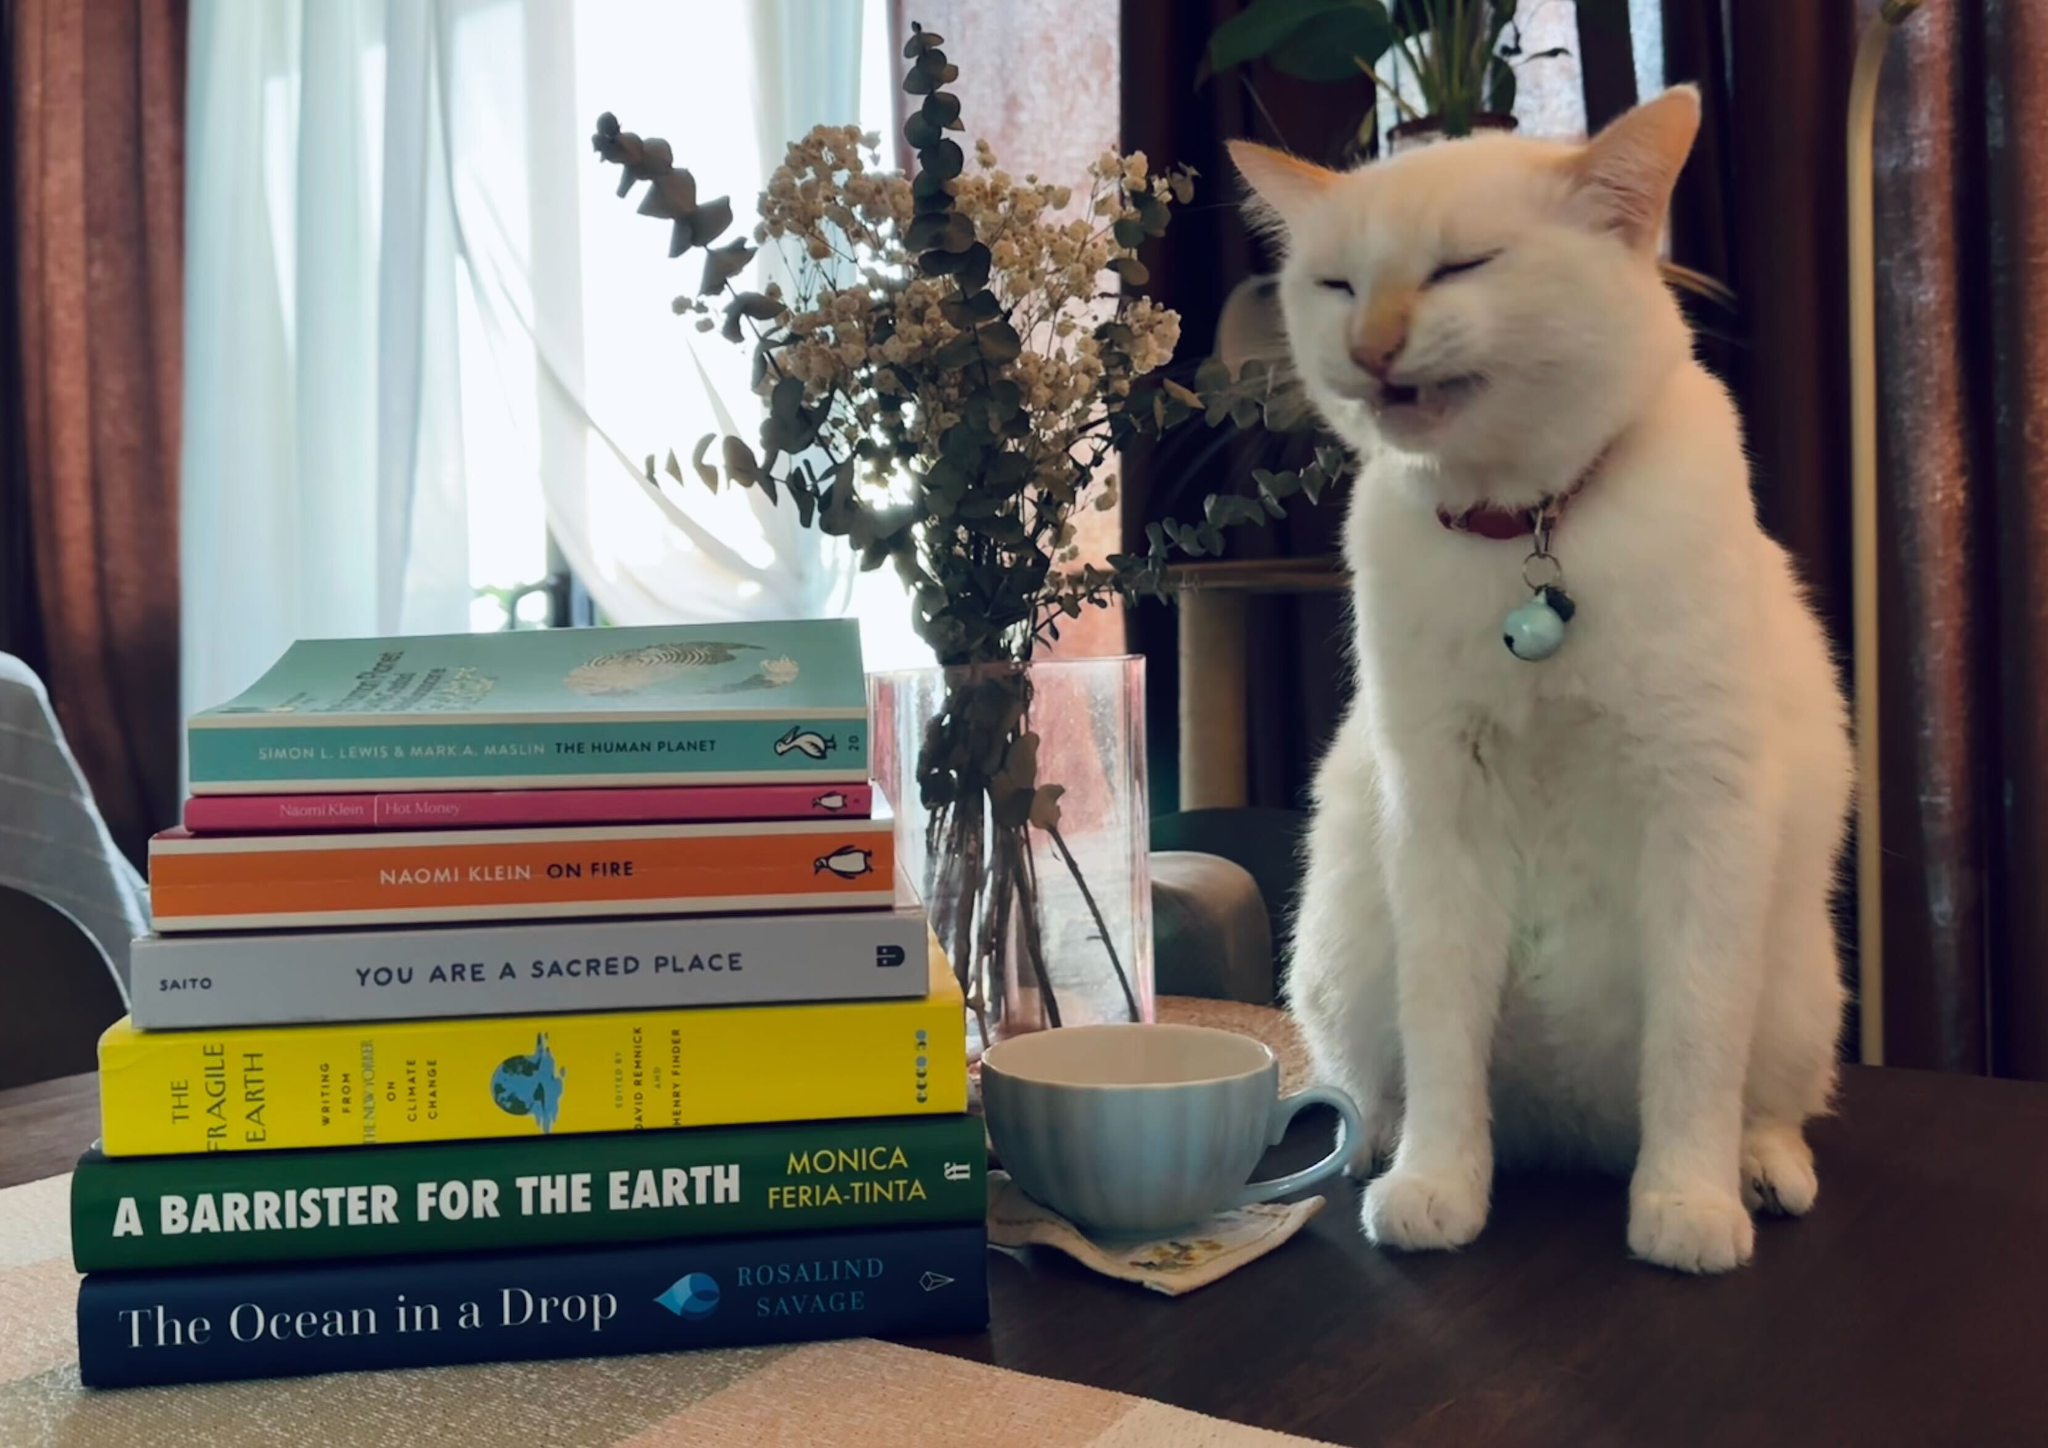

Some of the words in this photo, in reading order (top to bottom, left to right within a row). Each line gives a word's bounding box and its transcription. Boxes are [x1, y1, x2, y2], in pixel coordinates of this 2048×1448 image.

[259, 747, 314, 760] SIMON
[320, 747, 334, 759] L.
[339, 746, 389, 759] LEWIS
[394, 745, 405, 758] &
[410, 744, 457, 757] MARK
[462, 744, 478, 757] A.
[484, 743, 545, 756] MASLIN
[555, 741, 586, 754] THE
[591, 740, 651, 753] HUMAN
[657, 739, 717, 752] PLANET
[280, 804, 326, 817] Naomi
[328, 803, 364, 816] Klein
[385, 802, 411, 814] Hot
[414, 802, 461, 816] Money
[380, 867, 459, 885] NAOMI
[469, 865, 531, 882] KLEIN
[547, 863, 582, 879] ON
[591, 861, 634, 878] FIRE
[159, 978, 212, 991] SAITO
[356, 967, 414, 987] YOU
[429, 963, 486, 983] ARE
[499, 961, 517, 980] A
[531, 956, 640, 978] SACRED
[654, 953, 743, 973] PLACE
[633, 1027, 642, 1086] REMNICK
[671, 1029, 681, 1076] FINDER
[171, 1080, 189, 1124] THE
[242, 1053, 266, 1142] EARTH
[320, 1062, 331, 1126] WRITING
[341, 1073, 351, 1113] FROM
[386, 1081, 396, 1102] ON
[406, 1059, 417, 1122] CLIMATE
[427, 1059, 438, 1120] CHANGE
[614, 1068, 623, 1108] EDITED
[672, 1082, 681, 1126] HENRY
[633, 1092, 643, 1129] DAVID
[787, 1146, 908, 1175] MONICA
[112, 1197, 144, 1237] A
[160, 1184, 399, 1235] BARRISTER
[417, 1179, 500, 1222] FOR
[515, 1172, 592, 1216] THE
[608, 1164, 740, 1210] EARTH
[768, 1179, 927, 1210] FERIA-TINTA
[737, 1258, 884, 1287] ROSALIND
[118, 1305, 211, 1348] The
[229, 1303, 379, 1342] Ocean
[396, 1295, 442, 1333] in
[458, 1300, 484, 1329] a
[499, 1287, 618, 1332] Drop
[757, 1291, 865, 1318] SAVAGE
